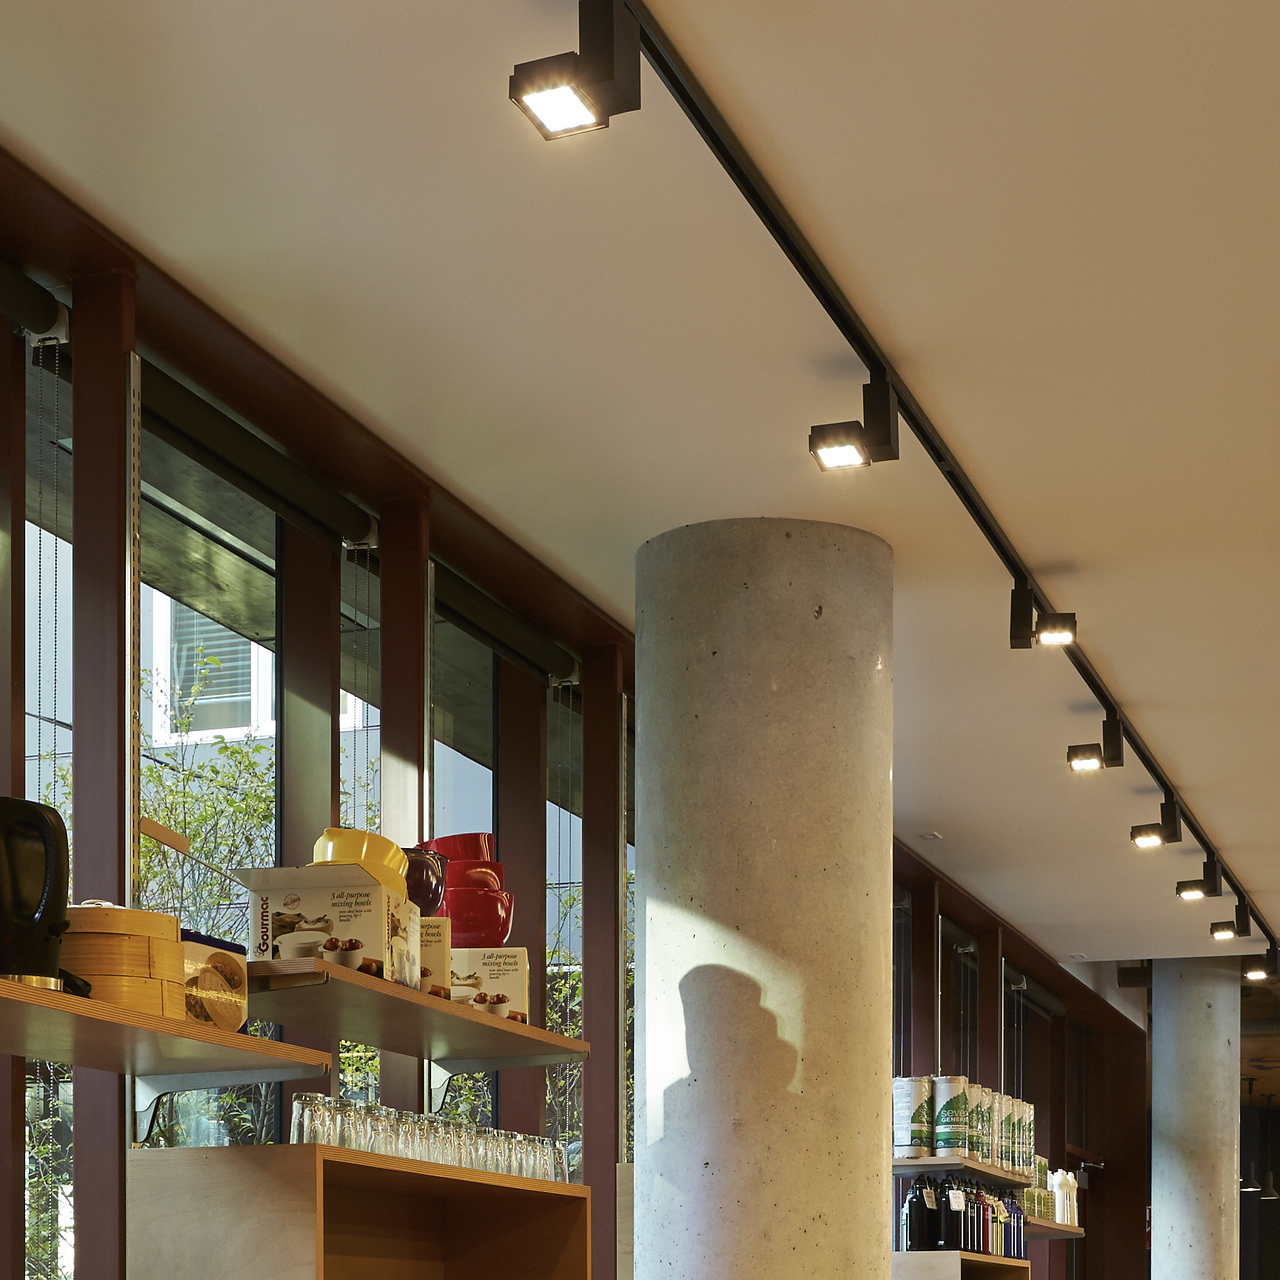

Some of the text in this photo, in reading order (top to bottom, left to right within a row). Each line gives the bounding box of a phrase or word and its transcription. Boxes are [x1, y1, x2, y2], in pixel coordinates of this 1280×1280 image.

[337, 891, 371, 901] all-purpose
[331, 899, 372, 909] mixing bowls
[258, 896, 269, 951] Gourmac
